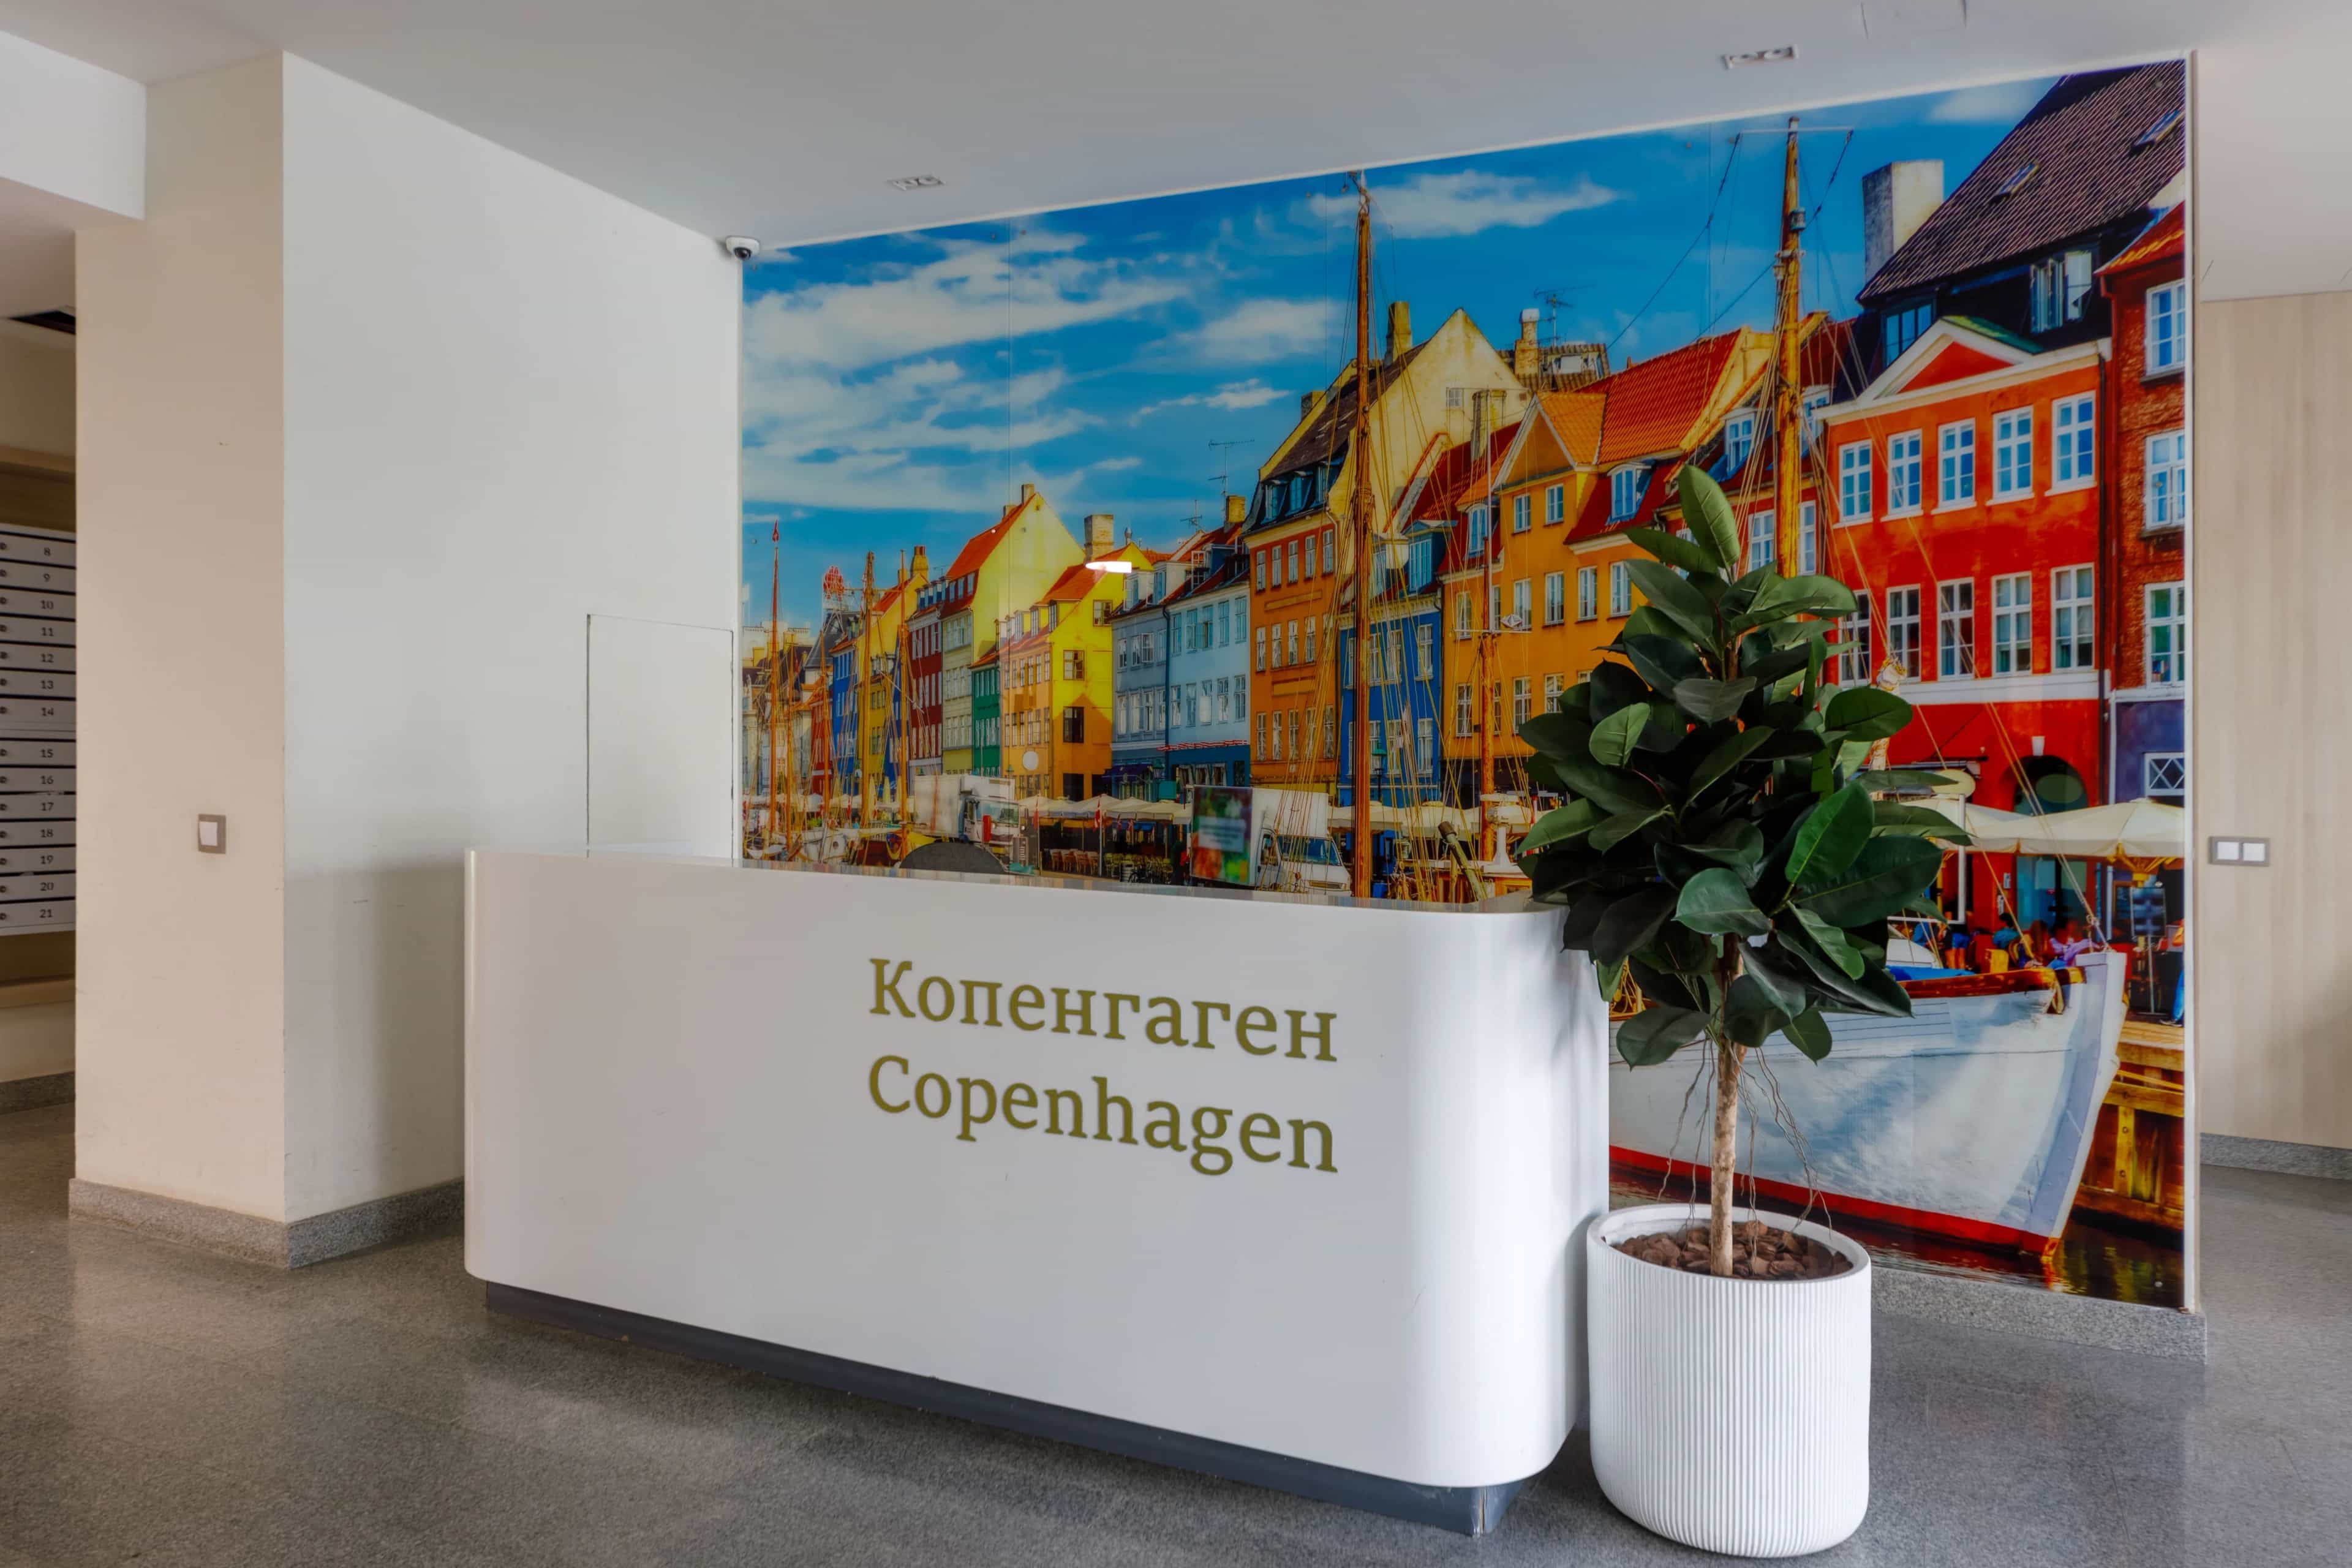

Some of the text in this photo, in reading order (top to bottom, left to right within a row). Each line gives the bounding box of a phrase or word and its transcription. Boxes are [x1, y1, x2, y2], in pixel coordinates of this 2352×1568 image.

[43, 547, 51, 557] 8
[43, 573, 51, 582] 9
[40, 600, 54, 610] 10
[41, 627, 55, 637] 11
[40, 653, 55, 663] 12
[40, 679, 55, 690] 13
[41, 707, 55, 717] 14
[40, 748, 55, 758] 15
[40, 775, 55, 785] 16
[41, 801, 55, 812] 17
[40, 828, 54, 839] 18
[40, 854, 54, 865] 19
[40, 881, 55, 892] 20
[39, 908, 53, 919] 21
[868, 957, 1338, 1063] Копенгаген
[867, 1054, 1339, 1177] Copenhagen
